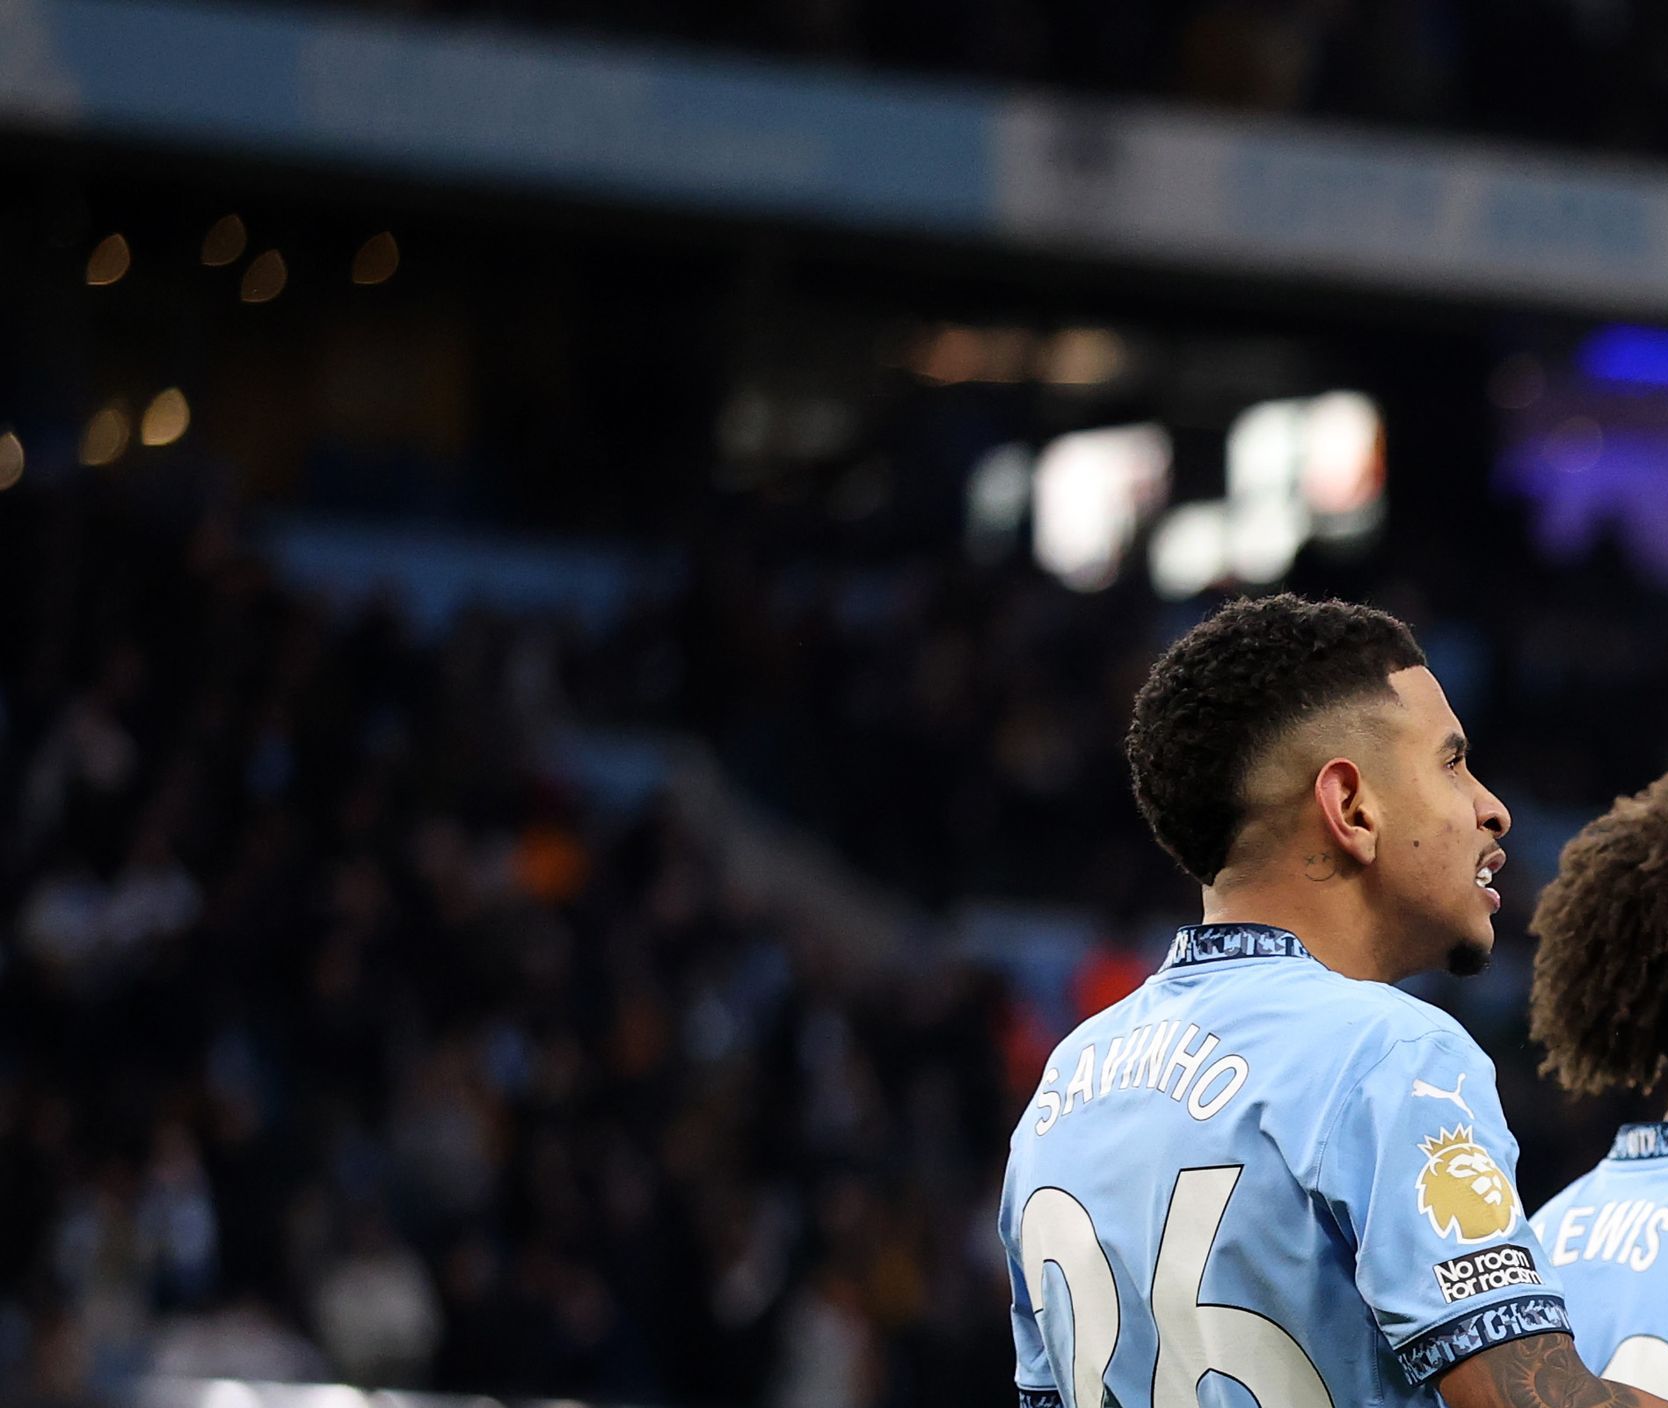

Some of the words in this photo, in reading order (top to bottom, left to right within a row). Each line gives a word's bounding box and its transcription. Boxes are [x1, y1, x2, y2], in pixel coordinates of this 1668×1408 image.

[1035, 1020, 1249, 1136] SAVINHO
[1434, 1261, 1473, 1285] No
[1474, 1249, 1530, 1272] room
[1442, 1277, 1476, 1303] for
[1480, 1267, 1543, 1291] racism
